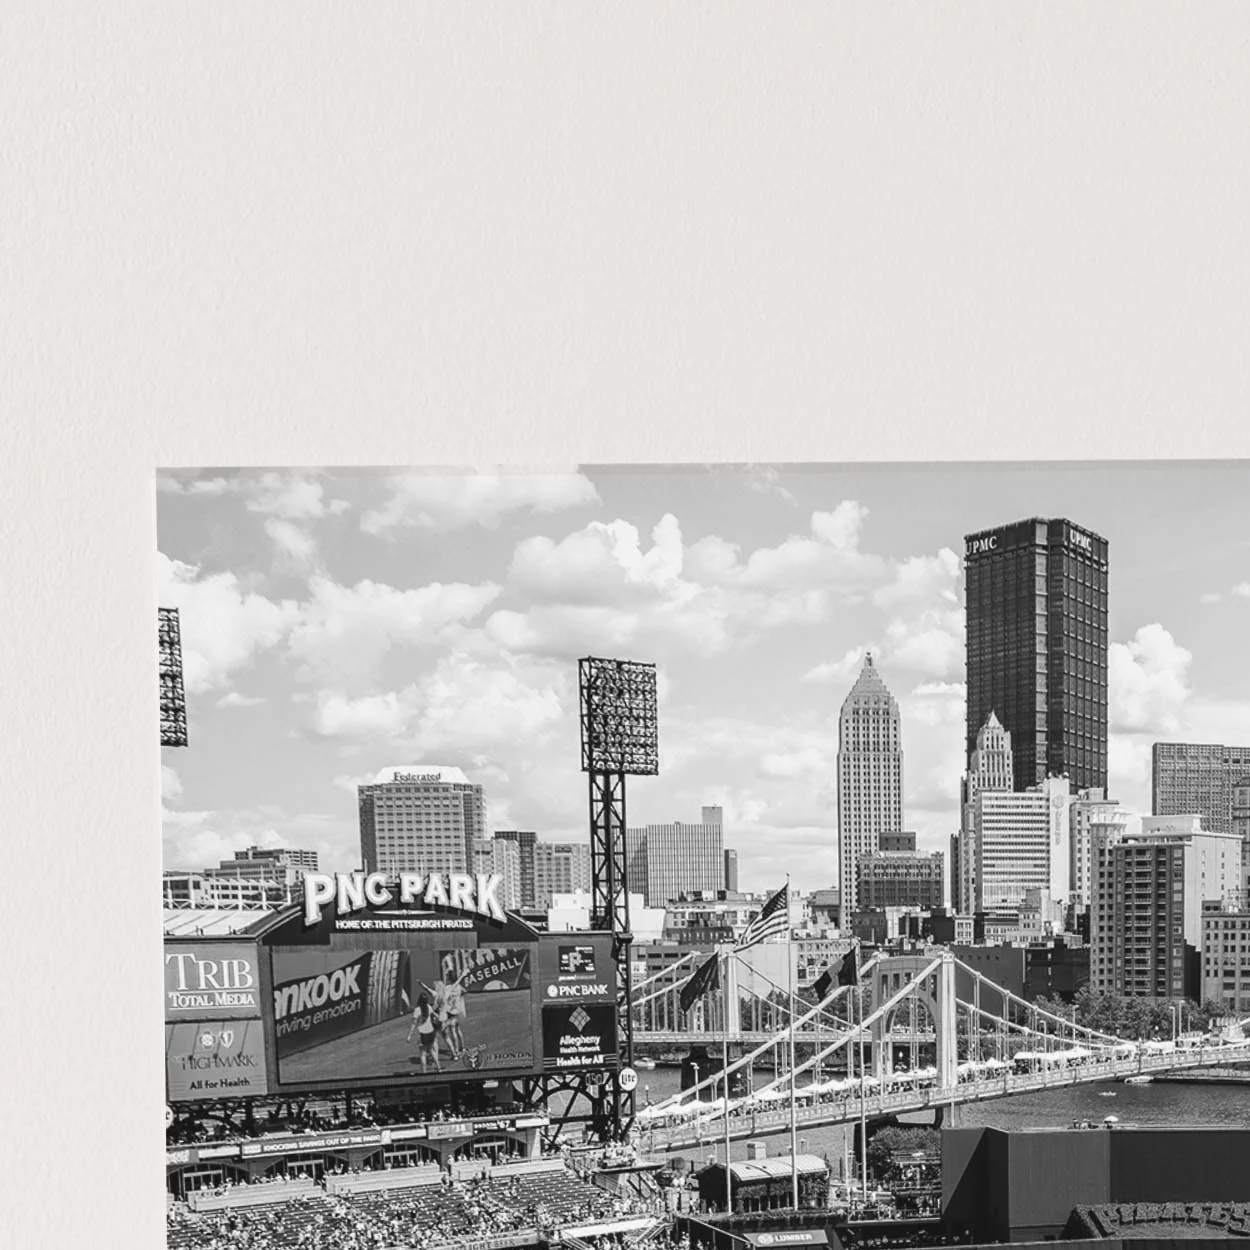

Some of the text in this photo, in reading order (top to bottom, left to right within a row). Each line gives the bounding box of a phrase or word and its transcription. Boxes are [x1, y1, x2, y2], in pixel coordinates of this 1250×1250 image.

[966, 536, 998, 554] UPMC
[1069, 528, 1092, 551] UPMC
[393, 771, 442, 782] Federated
[304, 871, 508, 927] PNC PARK
[335, 919, 474, 930] HOME OF THE PITTSBURGH PIRATES
[165, 953, 253, 991] TRIB
[559, 983, 609, 997] PNC BANK
[168, 990, 256, 1008] TOTAL MEDIA
[312, 998, 362, 1024] emotion
[559, 1034, 601, 1047] Allegheny
[190, 1077, 250, 1090] All for Health
[621, 1072, 636, 1086] Lite
[774, 1233, 813, 1243] LUMBER
